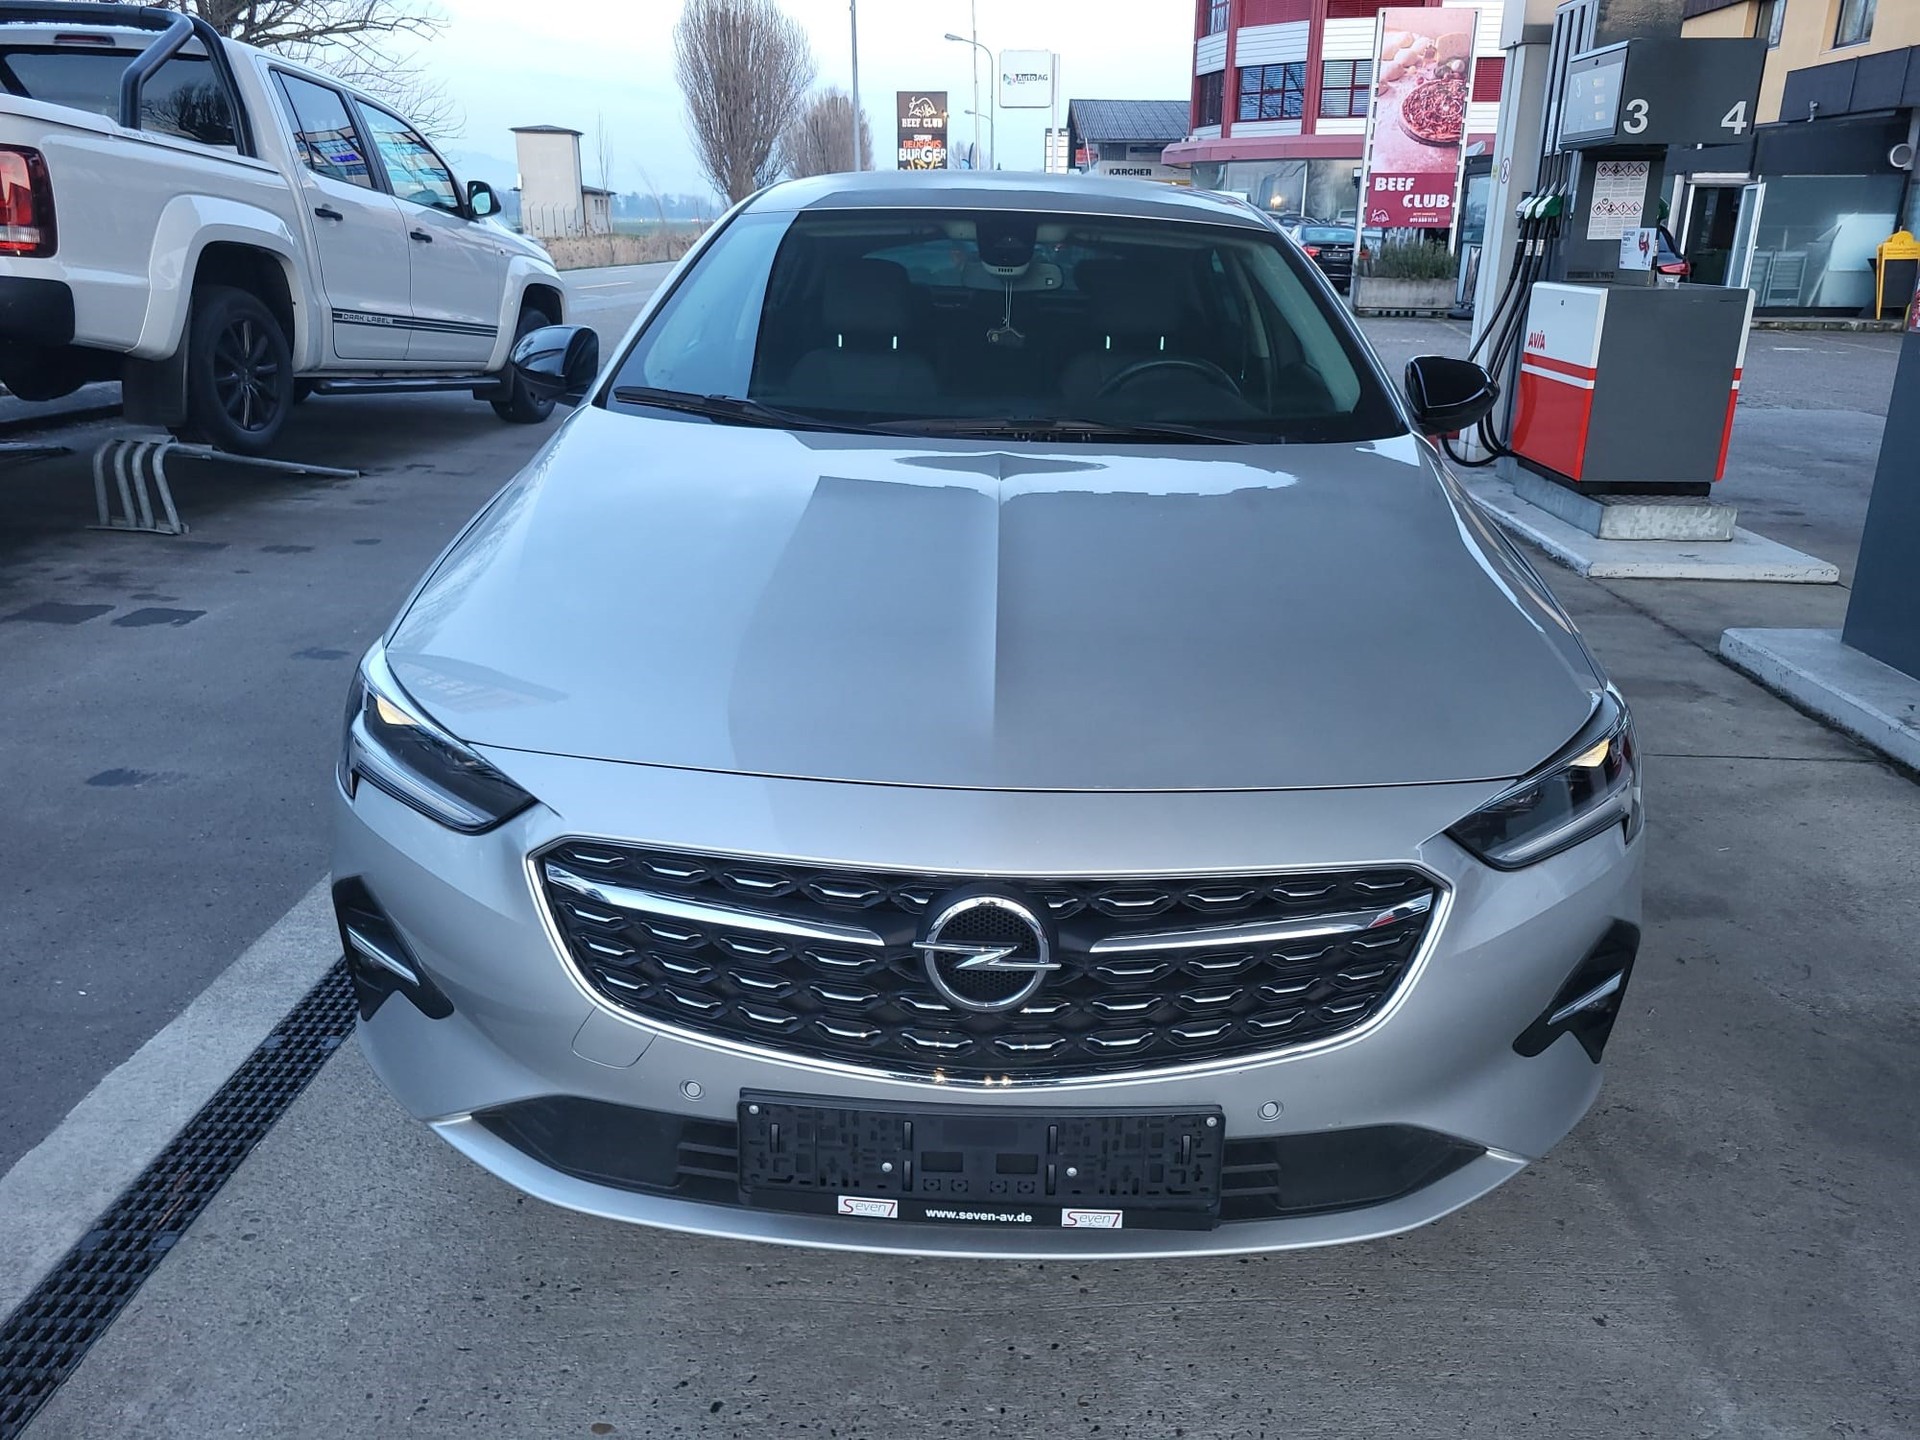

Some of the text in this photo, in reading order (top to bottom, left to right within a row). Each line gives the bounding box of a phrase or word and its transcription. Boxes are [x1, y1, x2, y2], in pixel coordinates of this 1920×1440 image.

[901, 118, 943, 128] BEEF CLUB
[1622, 98, 1650, 135] 3
[1721, 100, 1748, 135] 4
[898, 146, 947, 163] BURGER
[1374, 176, 1415, 192] BEEF
[1402, 194, 1450, 208] CLUB
[366, 315, 391, 324] LABEL
[925, 1208, 1033, 1223] www.seven-av.de
